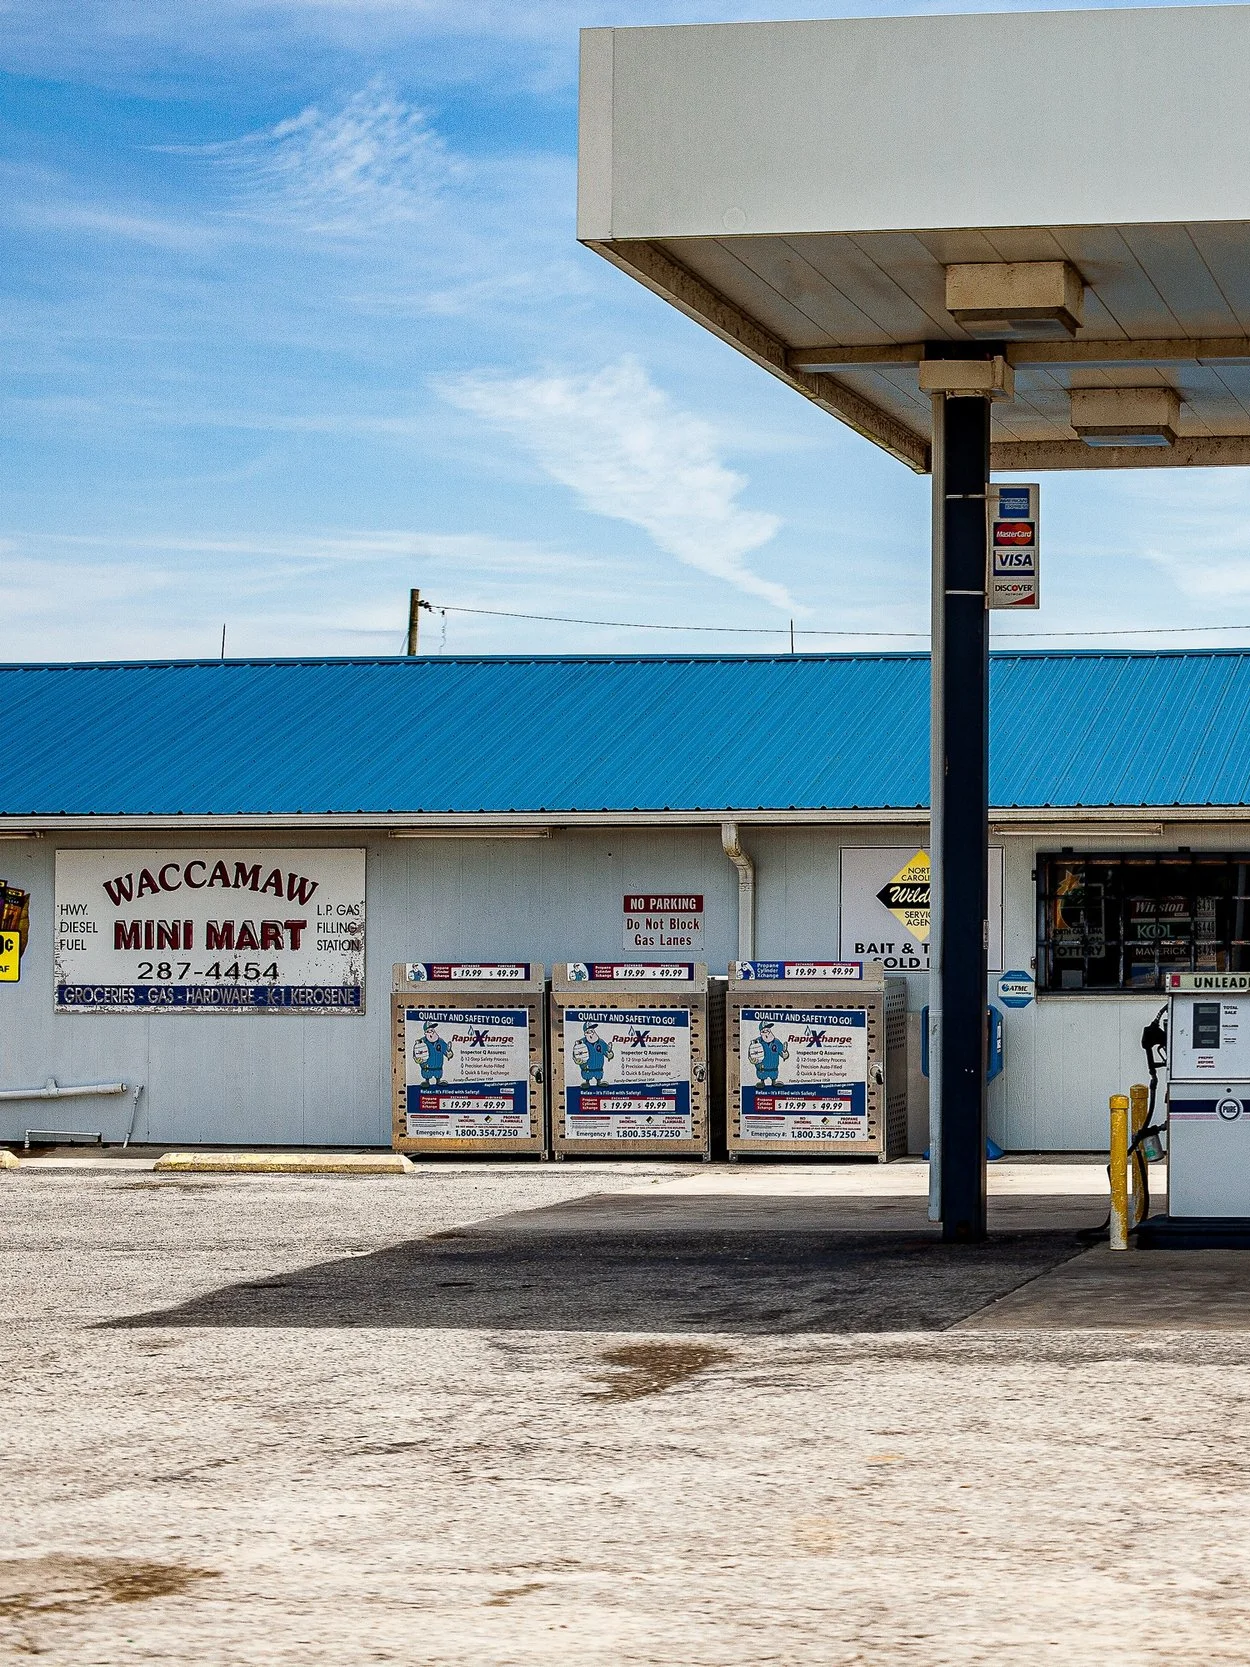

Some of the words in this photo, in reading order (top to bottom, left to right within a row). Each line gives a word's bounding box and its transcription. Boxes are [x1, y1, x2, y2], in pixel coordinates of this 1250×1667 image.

[997, 553, 1032, 566] VISA
[995, 584, 1032, 592] DISCOVER
[103, 860, 319, 906] WACCAMAW
[889, 885, 931, 903] Wild
[60, 904, 88, 915] HWY.
[317, 905, 333, 916] L.P.
[336, 904, 360, 916] GAS
[630, 898, 645, 910] NO
[650, 898, 697, 910] PARKING
[904, 911, 931, 919] SERVI
[60, 922, 98, 933] DIESEL
[317, 922, 358, 934] FILLING
[626, 918, 640, 930] Do
[645, 918, 664, 930] Not
[669, 918, 700, 930] Block
[114, 920, 193, 950] MINI
[206, 920, 307, 950] MART
[1136, 924, 1171, 938] KOOL
[60, 939, 87, 950] FUEL
[317, 940, 360, 951] STATION
[634, 934, 655, 946] Gas
[660, 934, 692, 946] Lanes
[854, 943, 895, 954] BAIT
[901, 942, 914, 954] &
[137, 962, 279, 980] 287-4454
[497, 969, 519, 977] 49.99
[831, 967, 854, 975] 49.99
[64, 987, 135, 1003] GROCERIES
[148, 987, 174, 1003] GAS
[186, 988, 255, 1004] HARDWARE
[291, 988, 355, 1005] KEROSENE
[418, 1012, 448, 1021] QUALITY
[448, 1013, 463, 1021] AND
[465, 1014, 490, 1023] SAFETY
[490, 1016, 499, 1024] TO
[499, 1016, 514, 1025] GO!
[578, 1012, 608, 1022] QUALITY
[608, 1013, 624, 1022] AND
[625, 1014, 651, 1023] SAFETY
[651, 1016, 661, 1024] TO
[661, 1016, 675, 1025] GO!
[754, 1012, 784, 1021] QUALITY
[785, 1013, 800, 1021] AND
[801, 1013, 828, 1023] SAFETY
[828, 1016, 838, 1024] TO
[838, 1016, 852, 1025] GO!
[821, 1102, 843, 1110] 49.99
[455, 1129, 518, 1137] 1.800.354.7250
[616, 1130, 681, 1138] 1.800.354.7250
[791, 1131, 856, 1139] 1.800.354.7250
